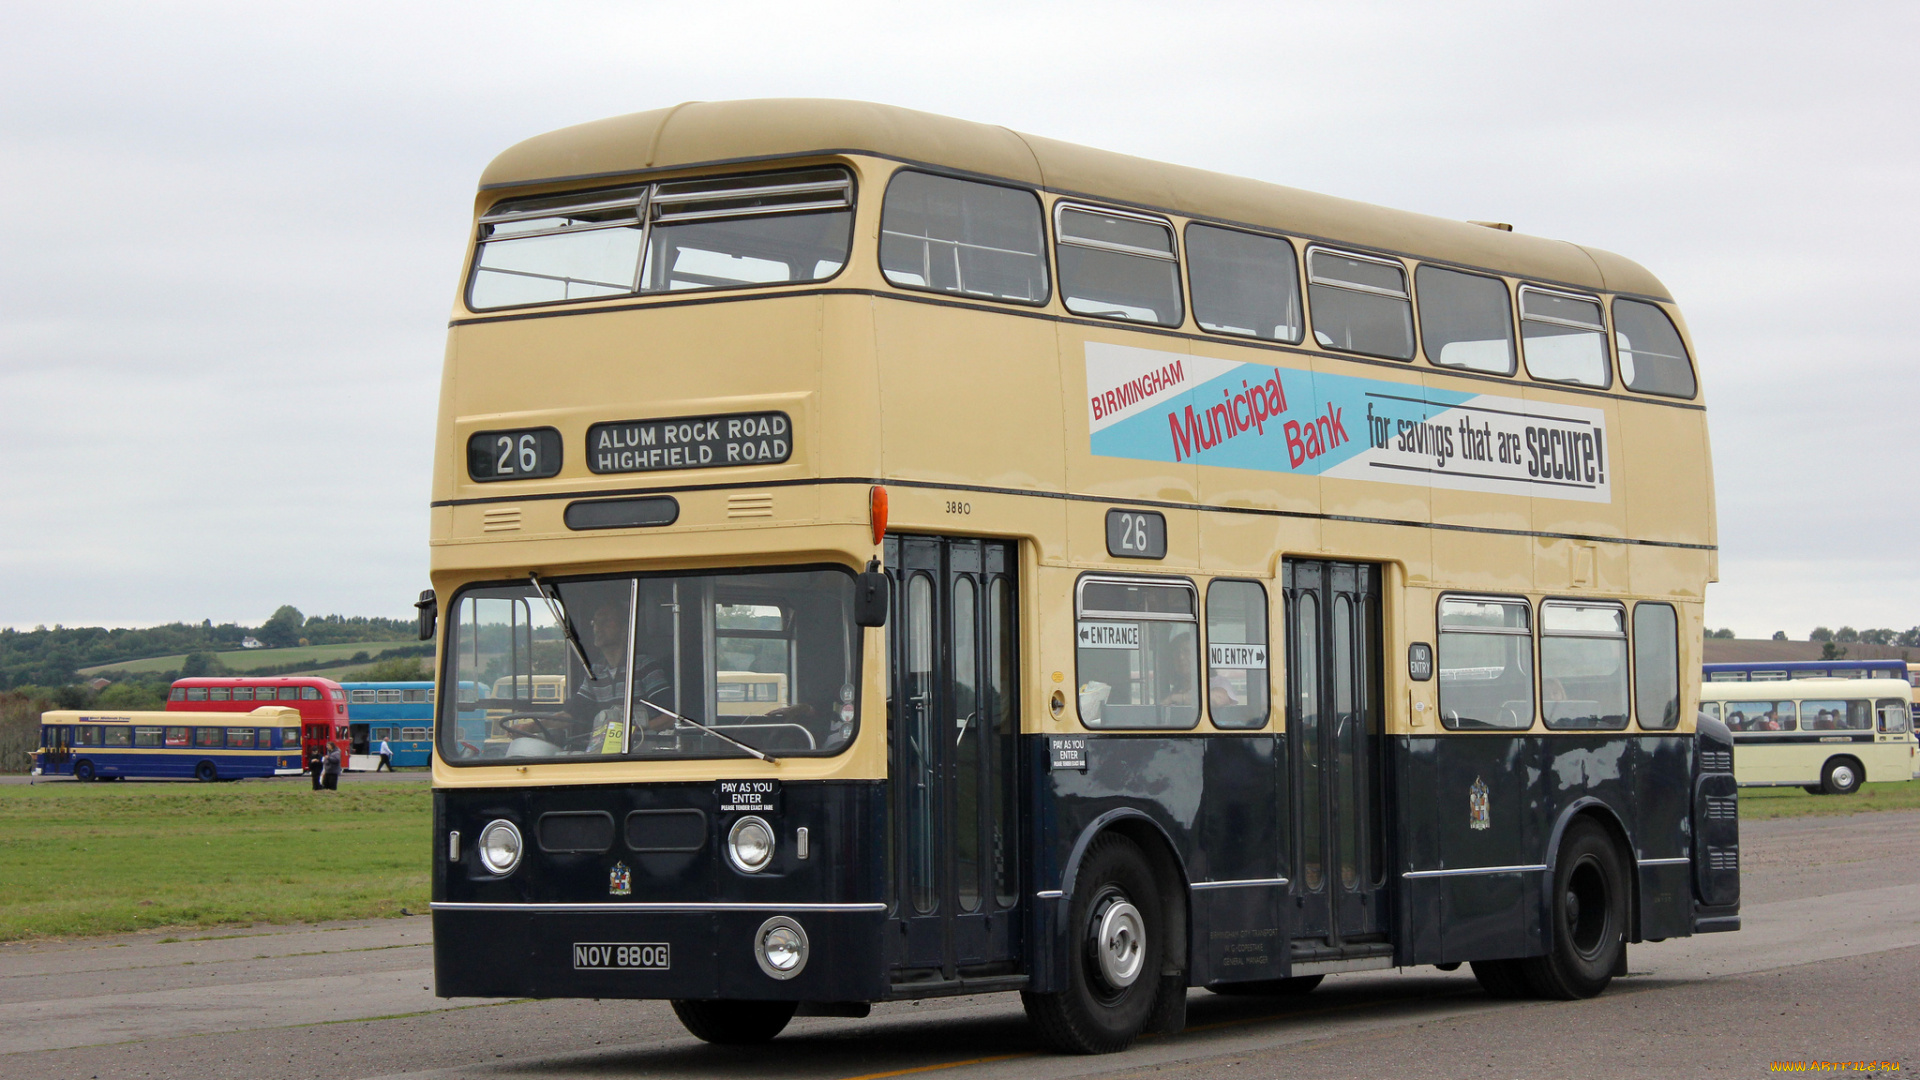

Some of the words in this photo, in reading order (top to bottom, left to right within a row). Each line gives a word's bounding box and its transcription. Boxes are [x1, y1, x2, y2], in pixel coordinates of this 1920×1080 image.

[1091, 360, 1185, 421] BIRMINGHAM
[1168, 367, 1288, 462] Municipal
[598, 427, 656, 449] ALUM
[664, 421, 720, 444] ROCK
[728, 416, 787, 438] ROAD
[1283, 401, 1349, 470] Bank
[1366, 402, 1391, 450] for
[1397, 413, 1454, 467] savings
[1458, 415, 1493, 462] that
[1498, 431, 1521, 465] are
[1526, 425, 1605, 484] secure!
[496, 434, 536, 474] 26
[599, 445, 713, 470] HIGHFIELD
[727, 439, 788, 461] ROAD
[945, 501, 971, 515] 3880
[1121, 513, 1147, 551] 26
[1090, 626, 1138, 645] ENTRANCE
[1211, 647, 1223, 665] NO
[1225, 647, 1254, 665] ENTRY
[1415, 648, 1425, 661] NO
[1410, 661, 1430, 674] ENTRY
[1053, 740, 1063, 749] PAY
[1064, 740, 1071, 749] AS
[1072, 740, 1085, 749] YOU
[1060, 750, 1078, 760] ENTER
[721, 782, 737, 793] PAY
[739, 782, 751, 793] AS
[753, 782, 773, 793] YOU
[732, 793, 762, 804] ENTER
[576, 946, 612, 967] NOV
[617, 946, 667, 967] 880G
